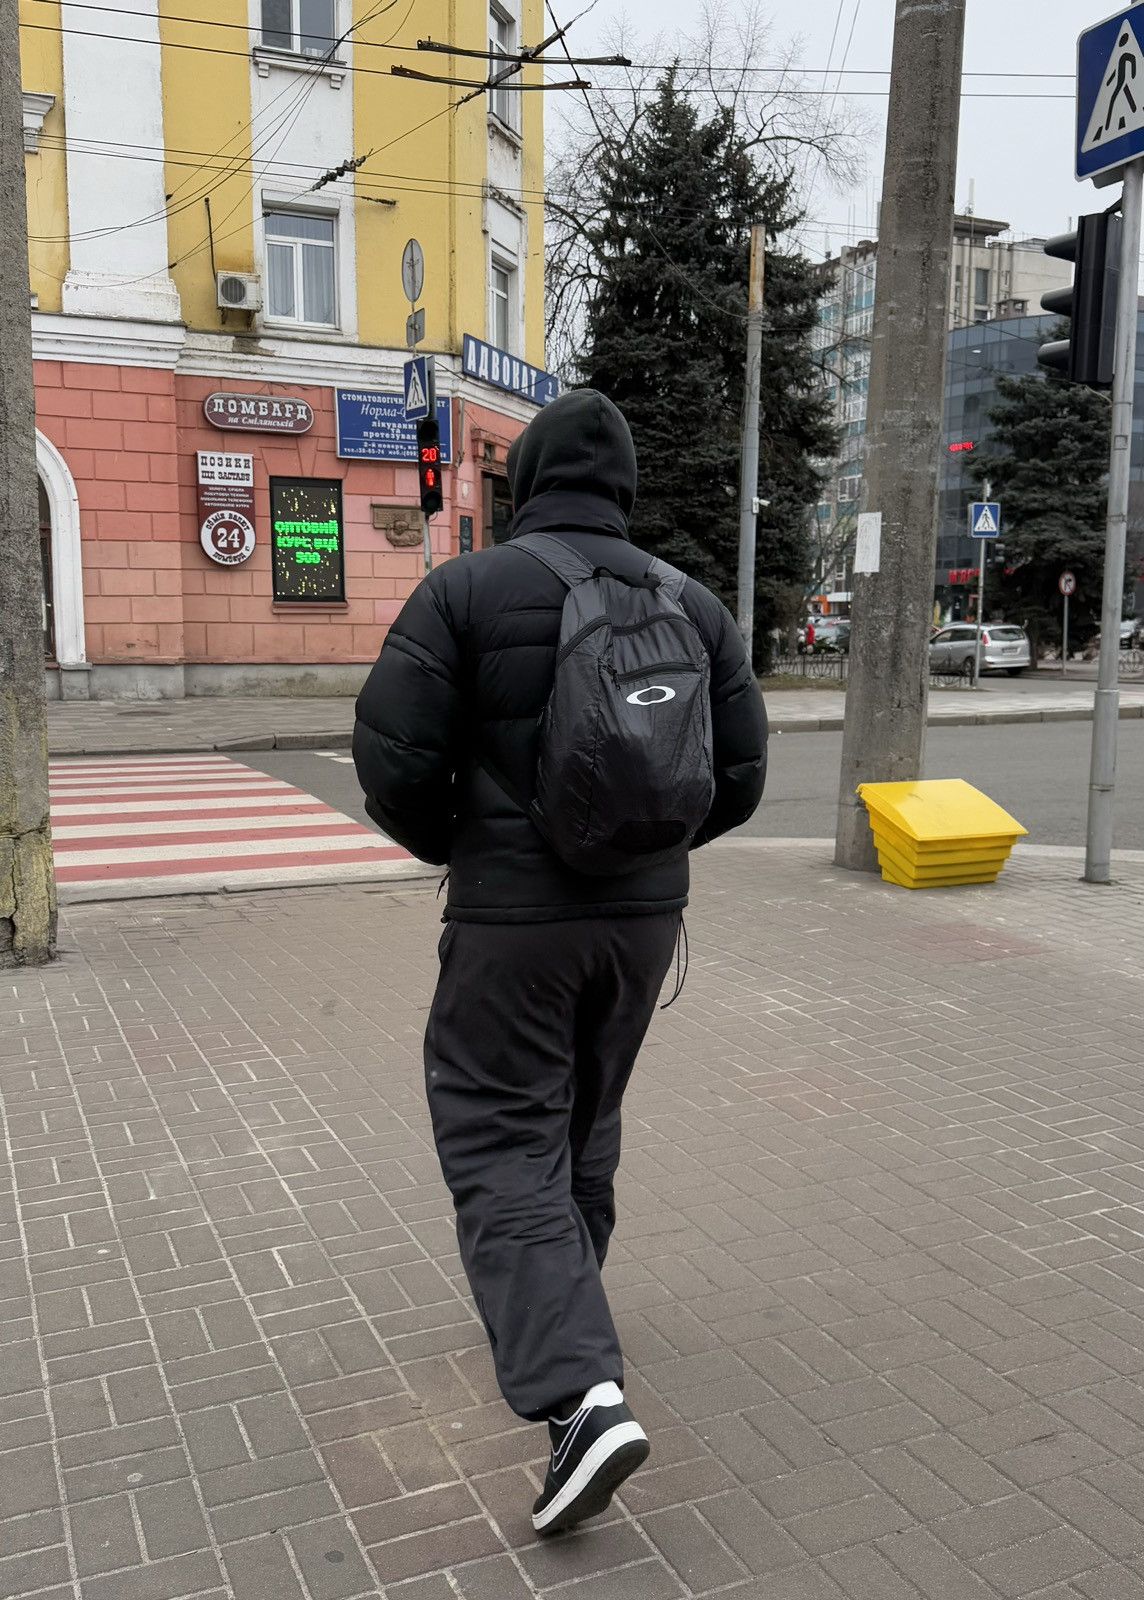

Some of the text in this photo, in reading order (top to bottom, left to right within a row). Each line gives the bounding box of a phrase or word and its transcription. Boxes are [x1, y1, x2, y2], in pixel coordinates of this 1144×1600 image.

[467, 339, 537, 398] АДВОКАТ
[341, 393, 405, 405] СТОМАТОЛОГІЧН
[213, 398, 308, 421] ЛОМБАРД
[228, 416, 239, 424] на
[200, 456, 251, 469] ПОЗИКИ
[217, 527, 240, 548] 24
